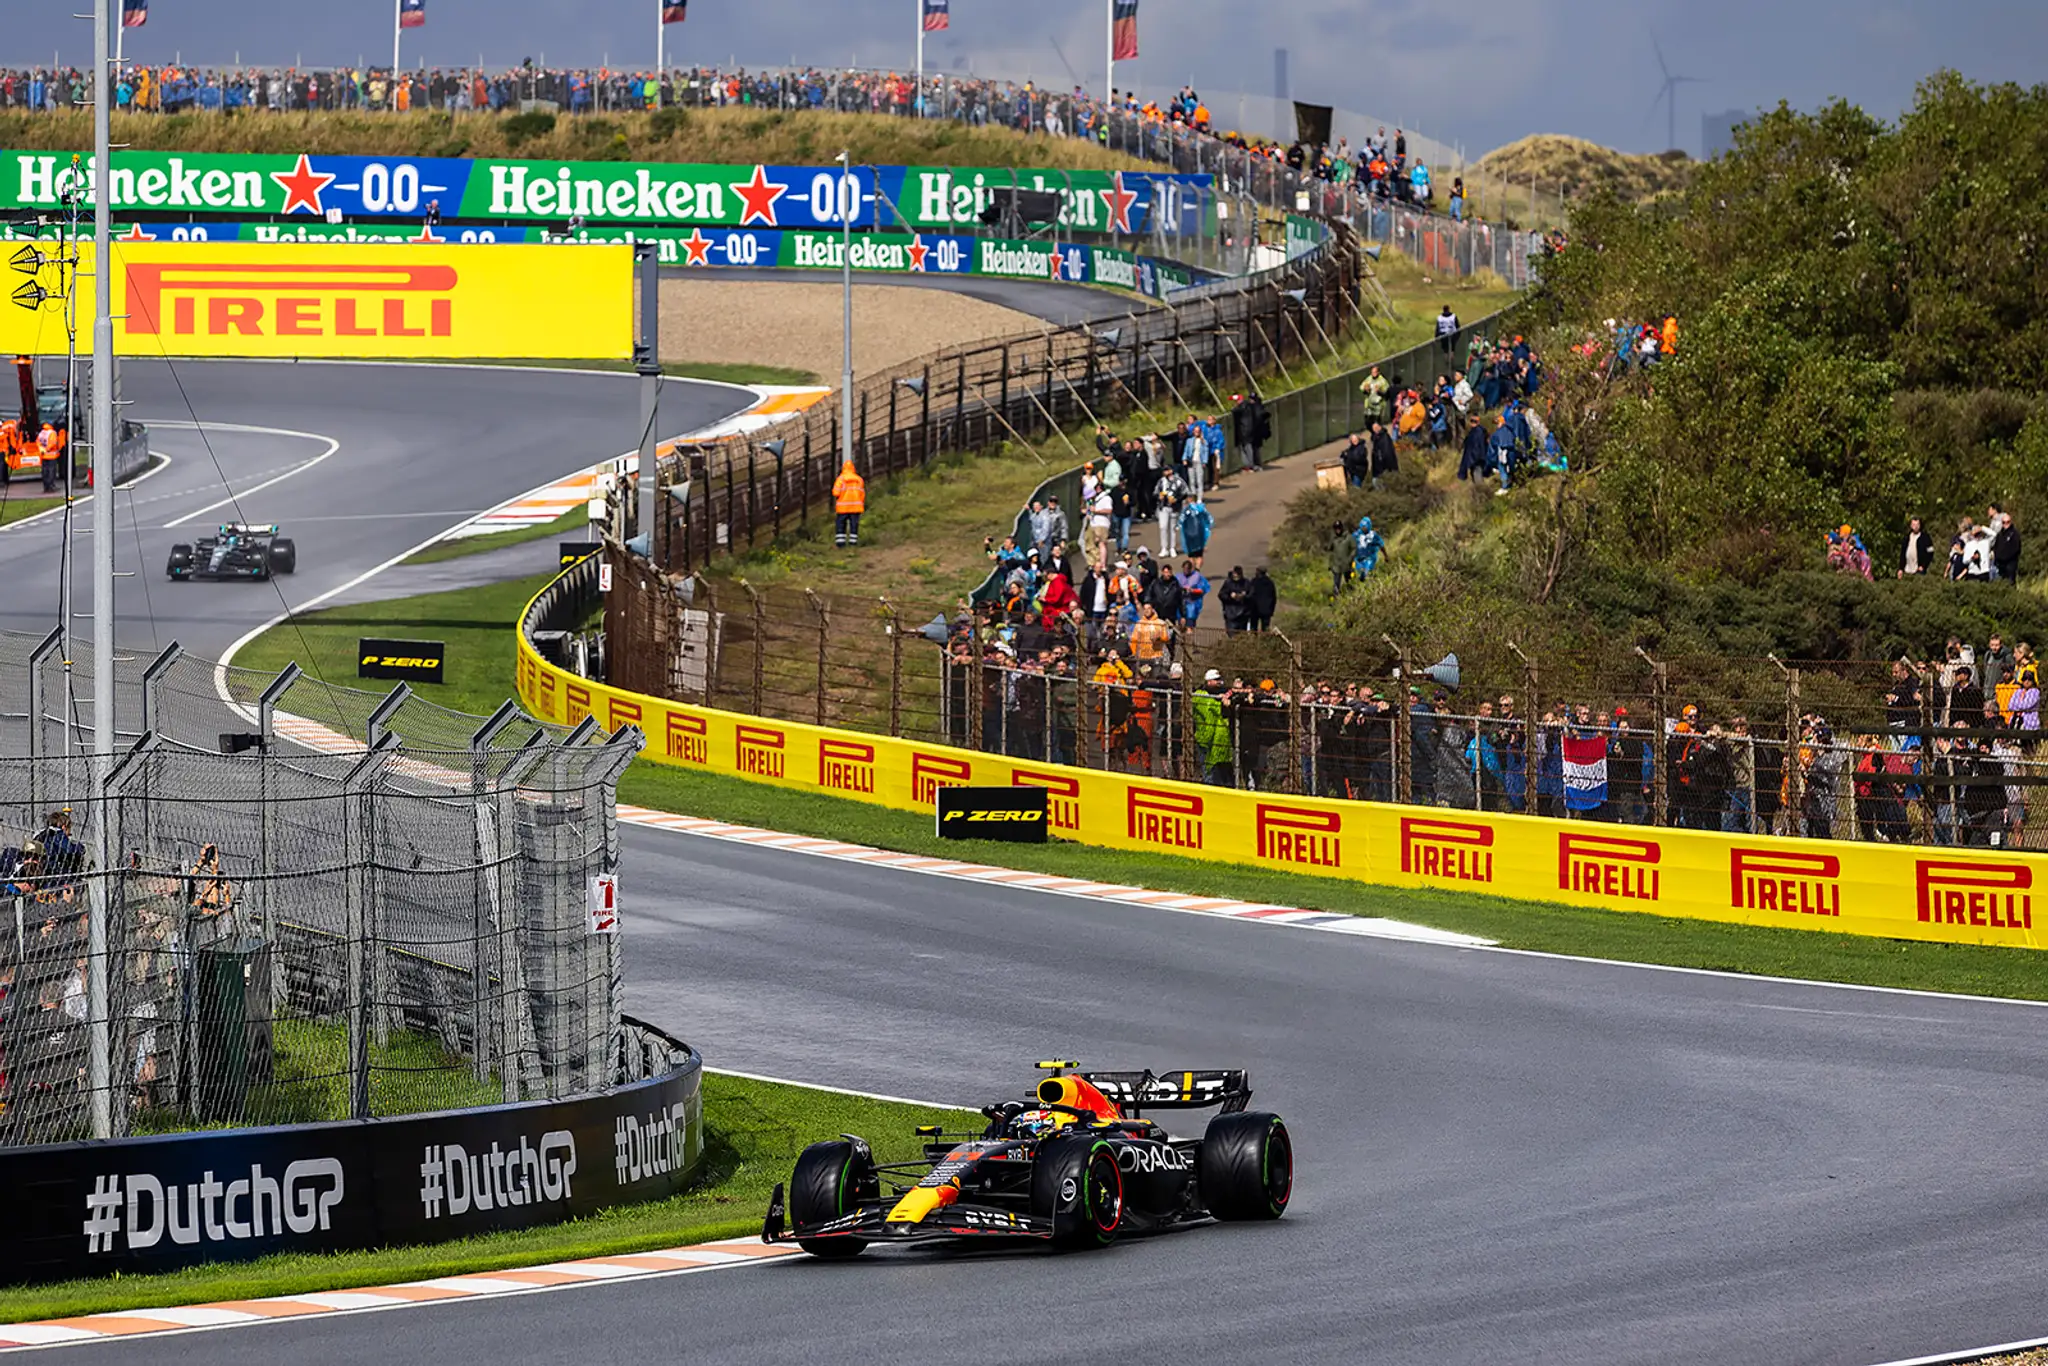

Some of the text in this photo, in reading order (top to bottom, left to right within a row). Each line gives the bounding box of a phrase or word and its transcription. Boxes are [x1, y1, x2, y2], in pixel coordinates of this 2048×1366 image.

[488, 165, 727, 219] Heineken
[981, 241, 1049, 276] Heineken
[125, 263, 459, 337] PIRELLI
[362, 655, 440, 668] P ZERO
[667, 711, 707, 764] PIRELLI
[736, 724, 785, 778] PIRELLI
[820, 738, 874, 793] PIRELLI
[943, 810, 1043, 821] P ZERO
[1127, 786, 1203, 850] PIRELLI
[1257, 803, 1341, 867] PIRELLI
[1401, 818, 1494, 883] PIRELLI
[1558, 832, 1661, 900] PIRELLI
[1730, 848, 1840, 917] PIRELLI
[1916, 860, 2032, 929] PIRELLI
[420, 1129, 577, 1219] #DutchGP
[615, 1101, 687, 1186] #DutchGP
[83, 1157, 344, 1254] #DutchGP
